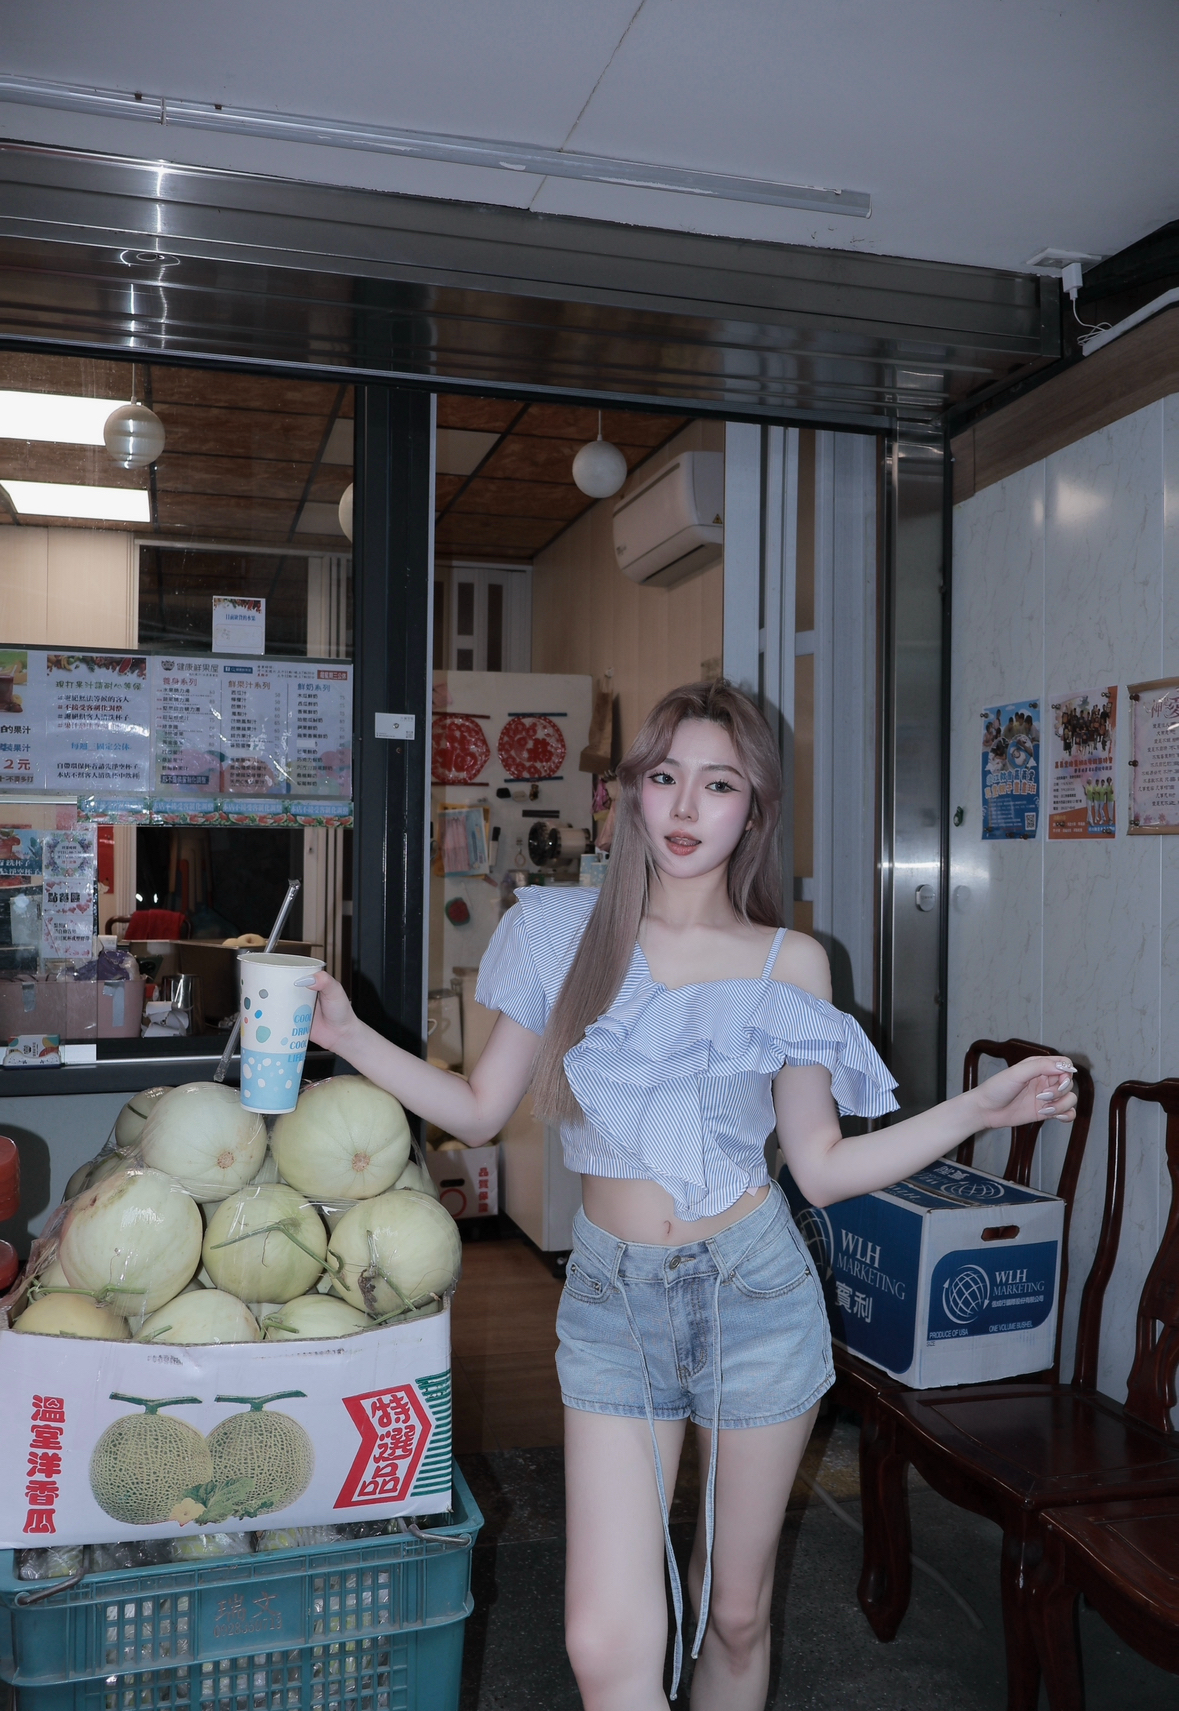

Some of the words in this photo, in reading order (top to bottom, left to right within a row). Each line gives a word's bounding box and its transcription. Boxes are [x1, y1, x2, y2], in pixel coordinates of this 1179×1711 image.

[176, 663, 219, 673] 健康鮮果屋
[162, 677, 198, 687] 養身系列
[228, 680, 271, 690] 鮮果汁系列
[297, 683, 331, 692] 鮮奶系列
[3, 759, 14, 769] 2
[18, 759, 31, 771] 元
[48, 892, 81, 903] 點餐區
[840, 1228, 881, 1268] WLH
[836, 1253, 906, 1300] MARKETING
[995, 1269, 1028, 1284] WLH
[993, 1281, 1045, 1297] MARKETING
[835, 1280, 873, 1324] 賓利
[988, 1325, 998, 1333] ONE
[998, 1323, 1017, 1331] VOLUME
[1016, 1321, 1034, 1329] BUSHEL
[929, 1330, 952, 1339] PRODUCE
[952, 1329, 959, 1337] OF
[357, 1394, 416, 1498] 特選品
[22, 1394, 66, 1534] 溫室洋香瓜
